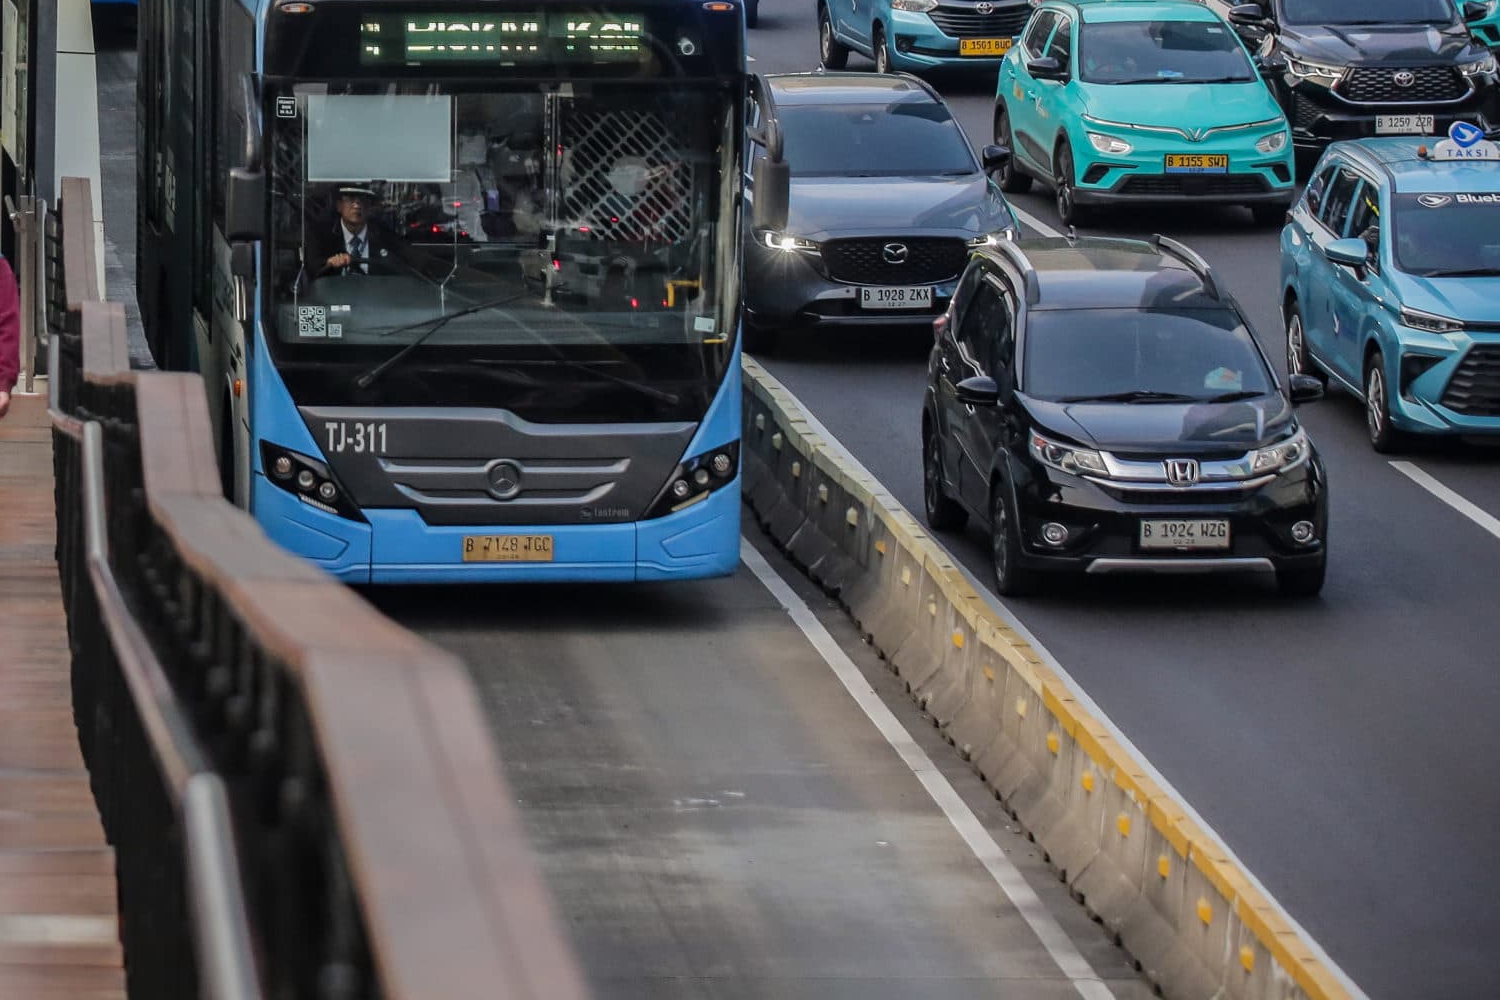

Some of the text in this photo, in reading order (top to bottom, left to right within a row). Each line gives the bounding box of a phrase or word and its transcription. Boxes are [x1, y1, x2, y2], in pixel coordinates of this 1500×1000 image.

[962, 41, 967, 49] B
[1377, 116, 1432, 127] B 1259 ZZR
[1446, 149, 1488, 157] TAKSI
[1167, 156, 1225, 167] B 1155 SWI
[864, 289, 929, 301] B 1928 ZKX
[325, 422, 386, 453] TJ-311
[1144, 523, 1226, 537] B 1924 WZG
[466, 537, 550, 552] B 7148 TGC
